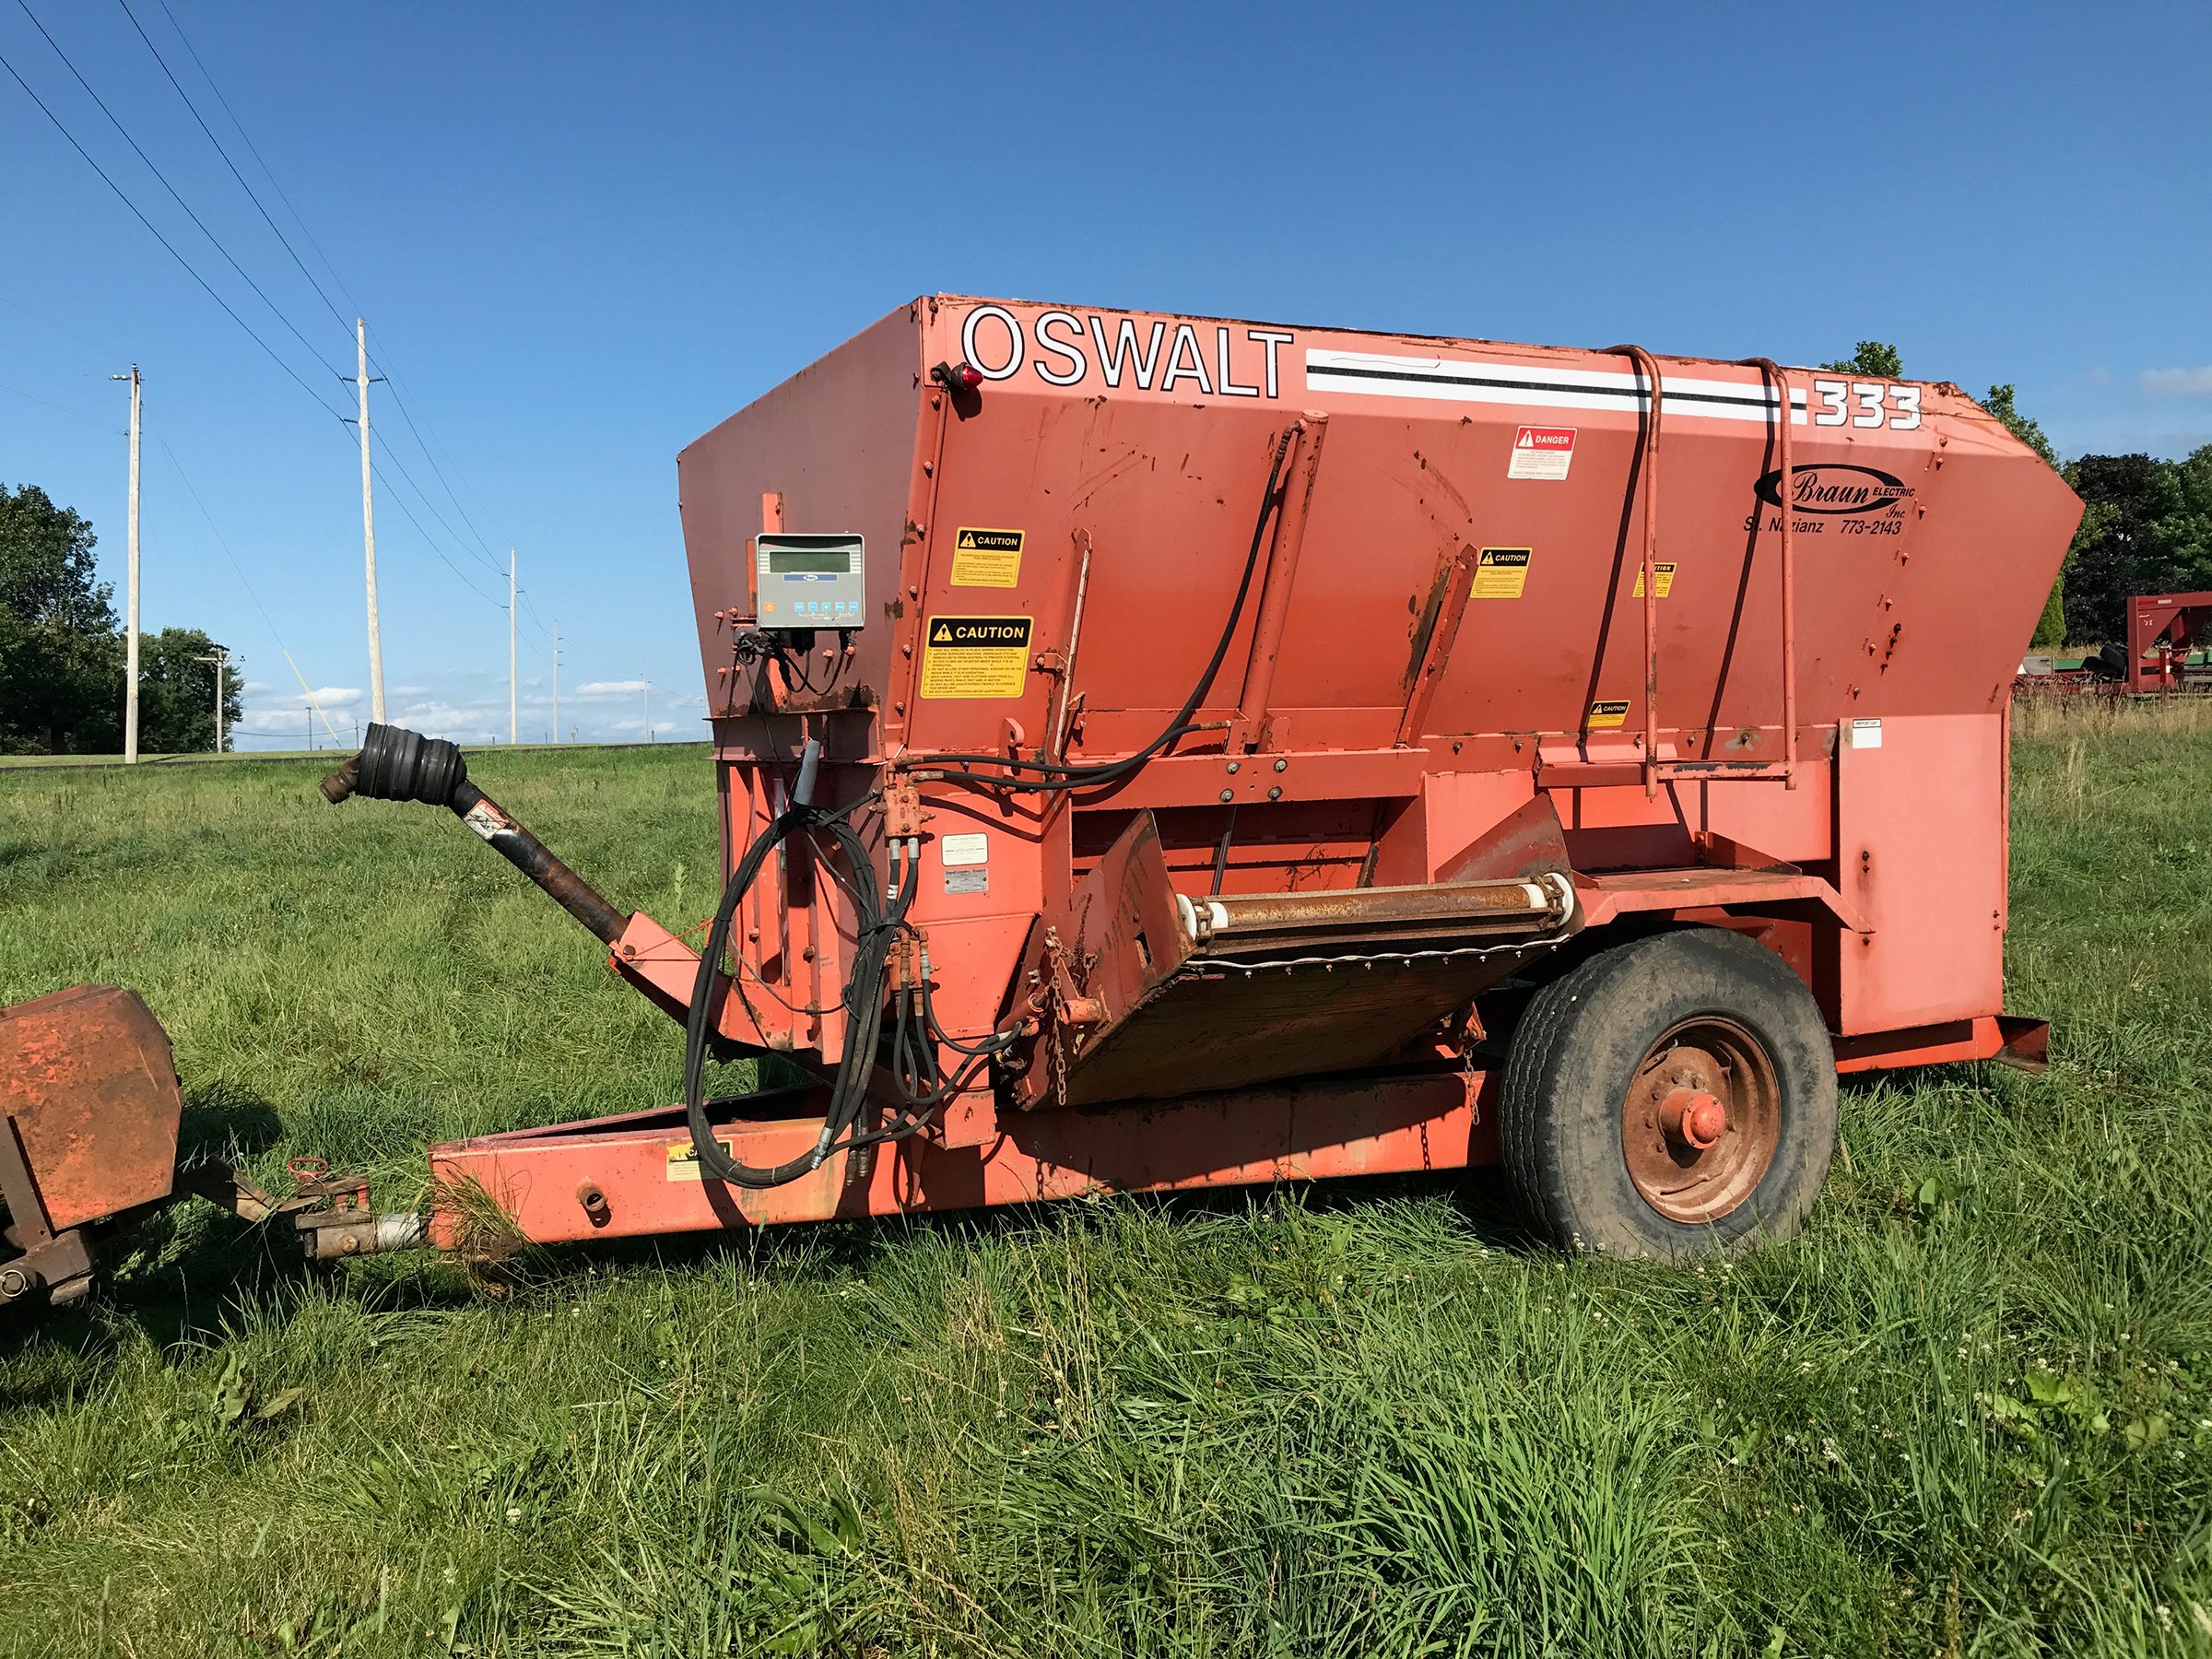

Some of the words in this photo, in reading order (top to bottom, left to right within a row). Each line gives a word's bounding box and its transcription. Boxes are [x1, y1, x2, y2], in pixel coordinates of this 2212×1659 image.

[961, 304, 1294, 399] OSWALT
[1814, 379, 1922, 430] 333
[1535, 435, 1570, 445] DANGER
[1791, 471, 1869, 504] Braun
[1872, 487, 1915, 498] ELECTRIC
[1769, 517, 1825, 534] Nianz
[1840, 519, 1902, 535] 773-2143
[977, 536, 1018, 547] CAUTION
[1495, 554, 1526, 562] CAUTION
[956, 627, 1024, 640] CAUTION
